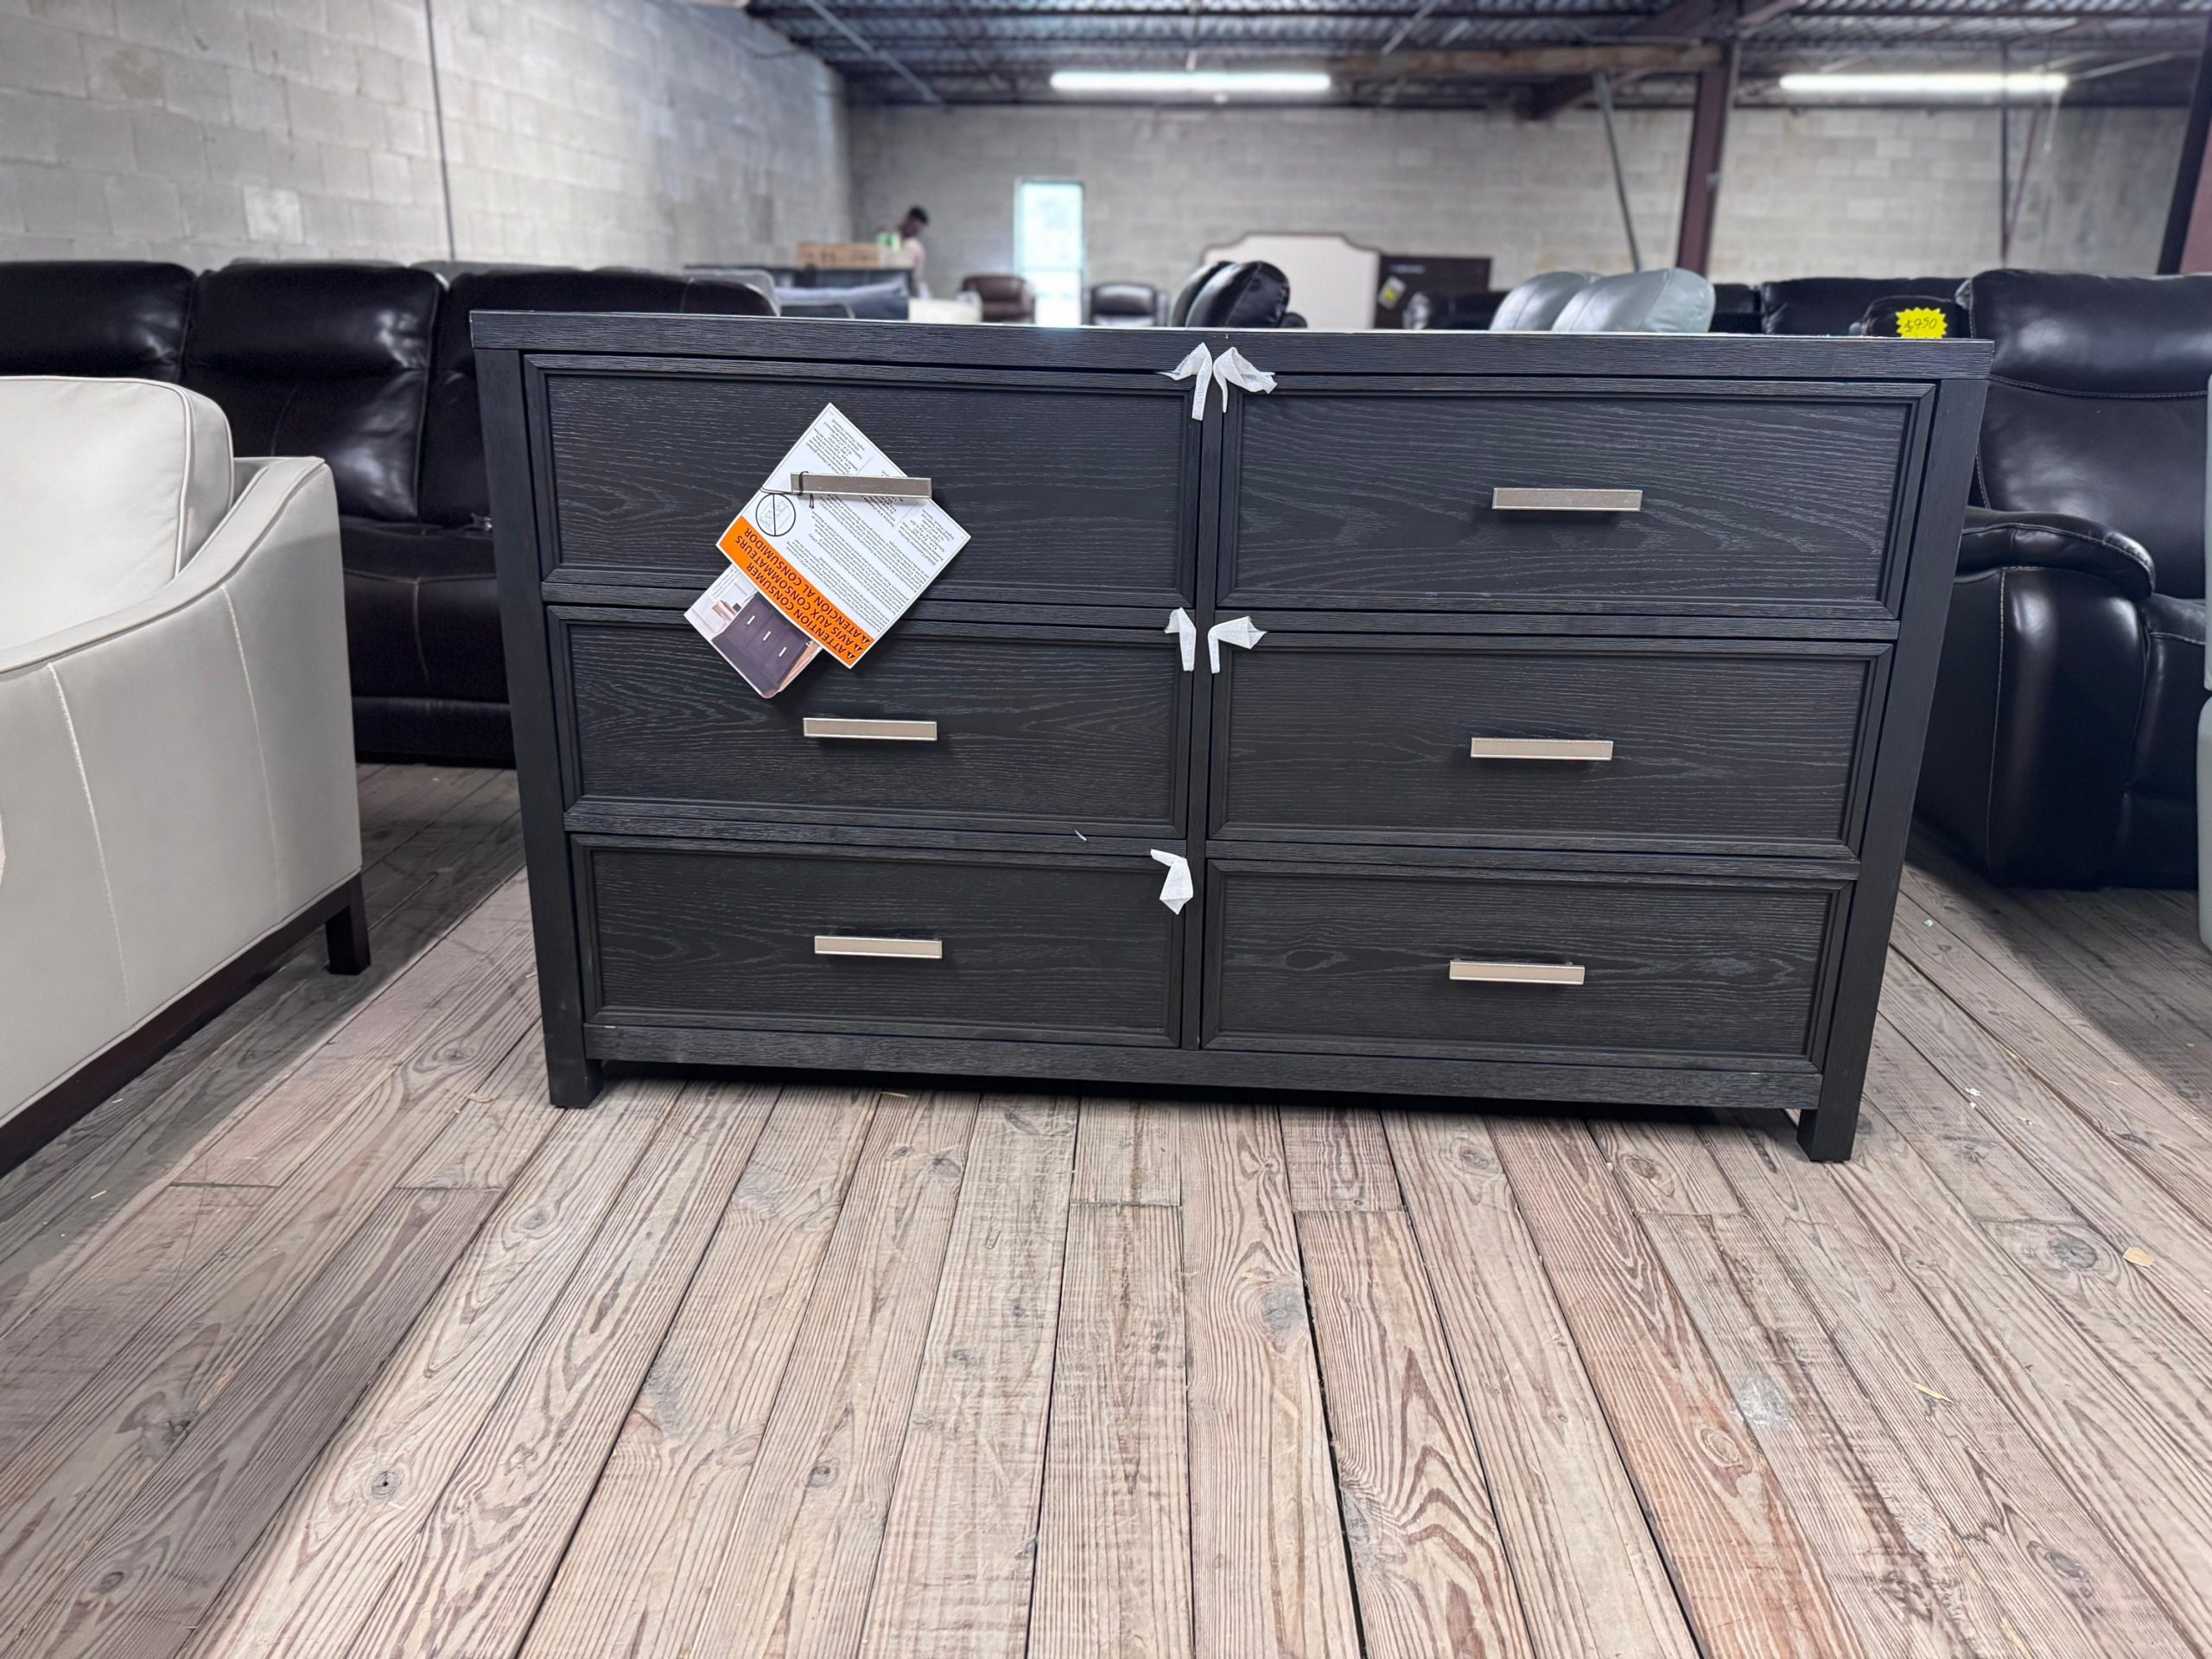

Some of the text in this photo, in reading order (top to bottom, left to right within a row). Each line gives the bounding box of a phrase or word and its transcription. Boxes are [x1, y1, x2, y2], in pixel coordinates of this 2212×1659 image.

[735, 536, 810, 609] CONSOMMATEURS
[745, 528, 801, 585] CONSUMIDOR
[747, 563, 793, 609] CONSUMER
[803, 584, 815, 597] AL
[793, 609, 846, 652] ATTENTION
[810, 609, 831, 627] AUX
[814, 596, 861, 637] ATENCIÓN
[831, 626, 853, 645] AVIS
